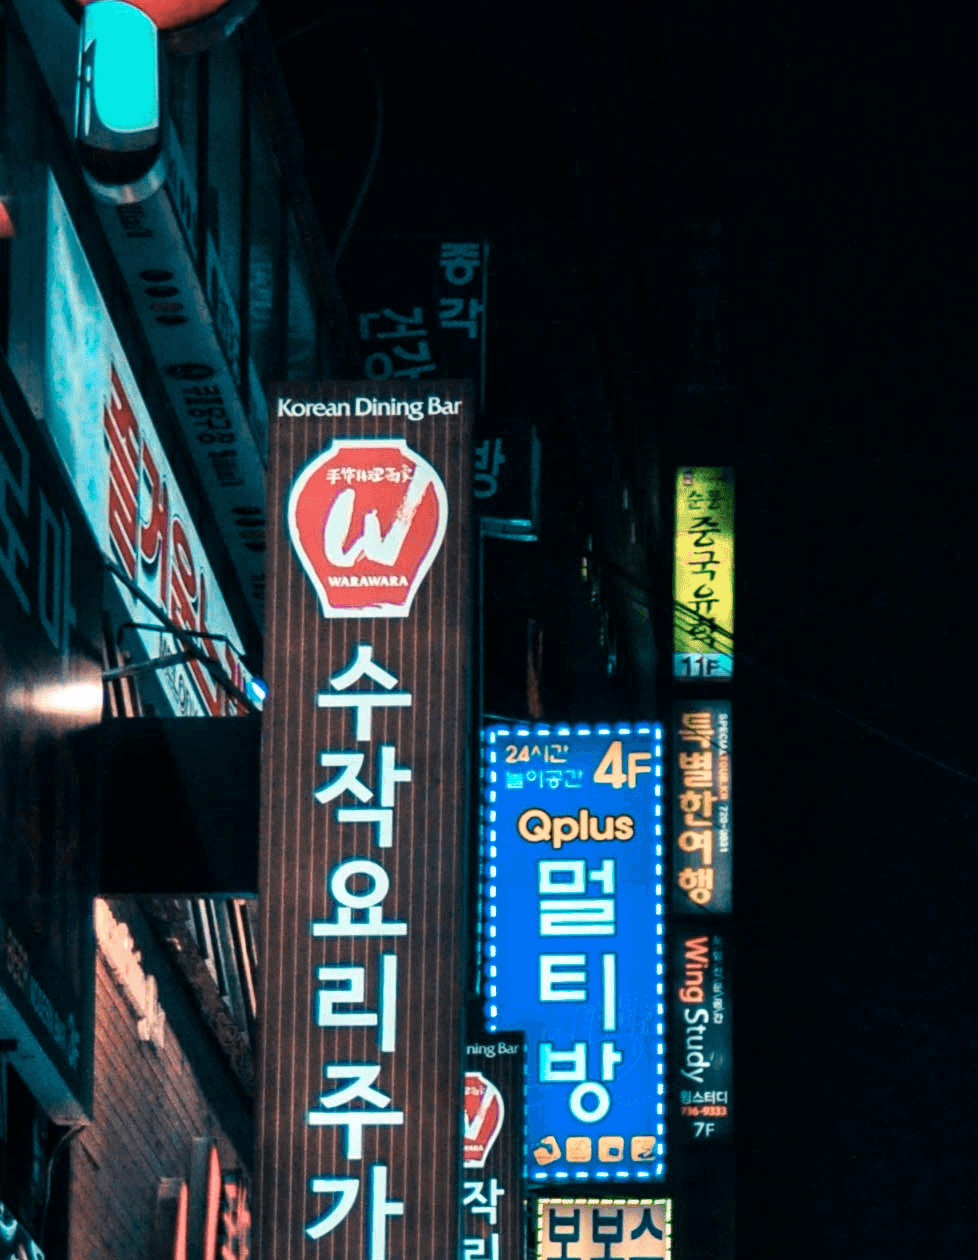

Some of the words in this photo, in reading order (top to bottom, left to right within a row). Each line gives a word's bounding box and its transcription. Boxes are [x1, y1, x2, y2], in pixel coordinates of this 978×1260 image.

[277, 397, 350, 417] Korean
[355, 397, 424, 421] Dining
[428, 397, 463, 415] Bar
[328, 576, 409, 587] WARAWARA
[505, 744, 569, 763] 24시간
[593, 740, 652, 789] 4F
[517, 808, 635, 849] Qplus
[678, 935, 710, 1003] Wing
[538, 858, 622, 1124] 멀티방
[497, 1043, 519, 1056] Bar
[680, 1008, 711, 1083] Study
[693, 1122, 716, 1138] 7F
